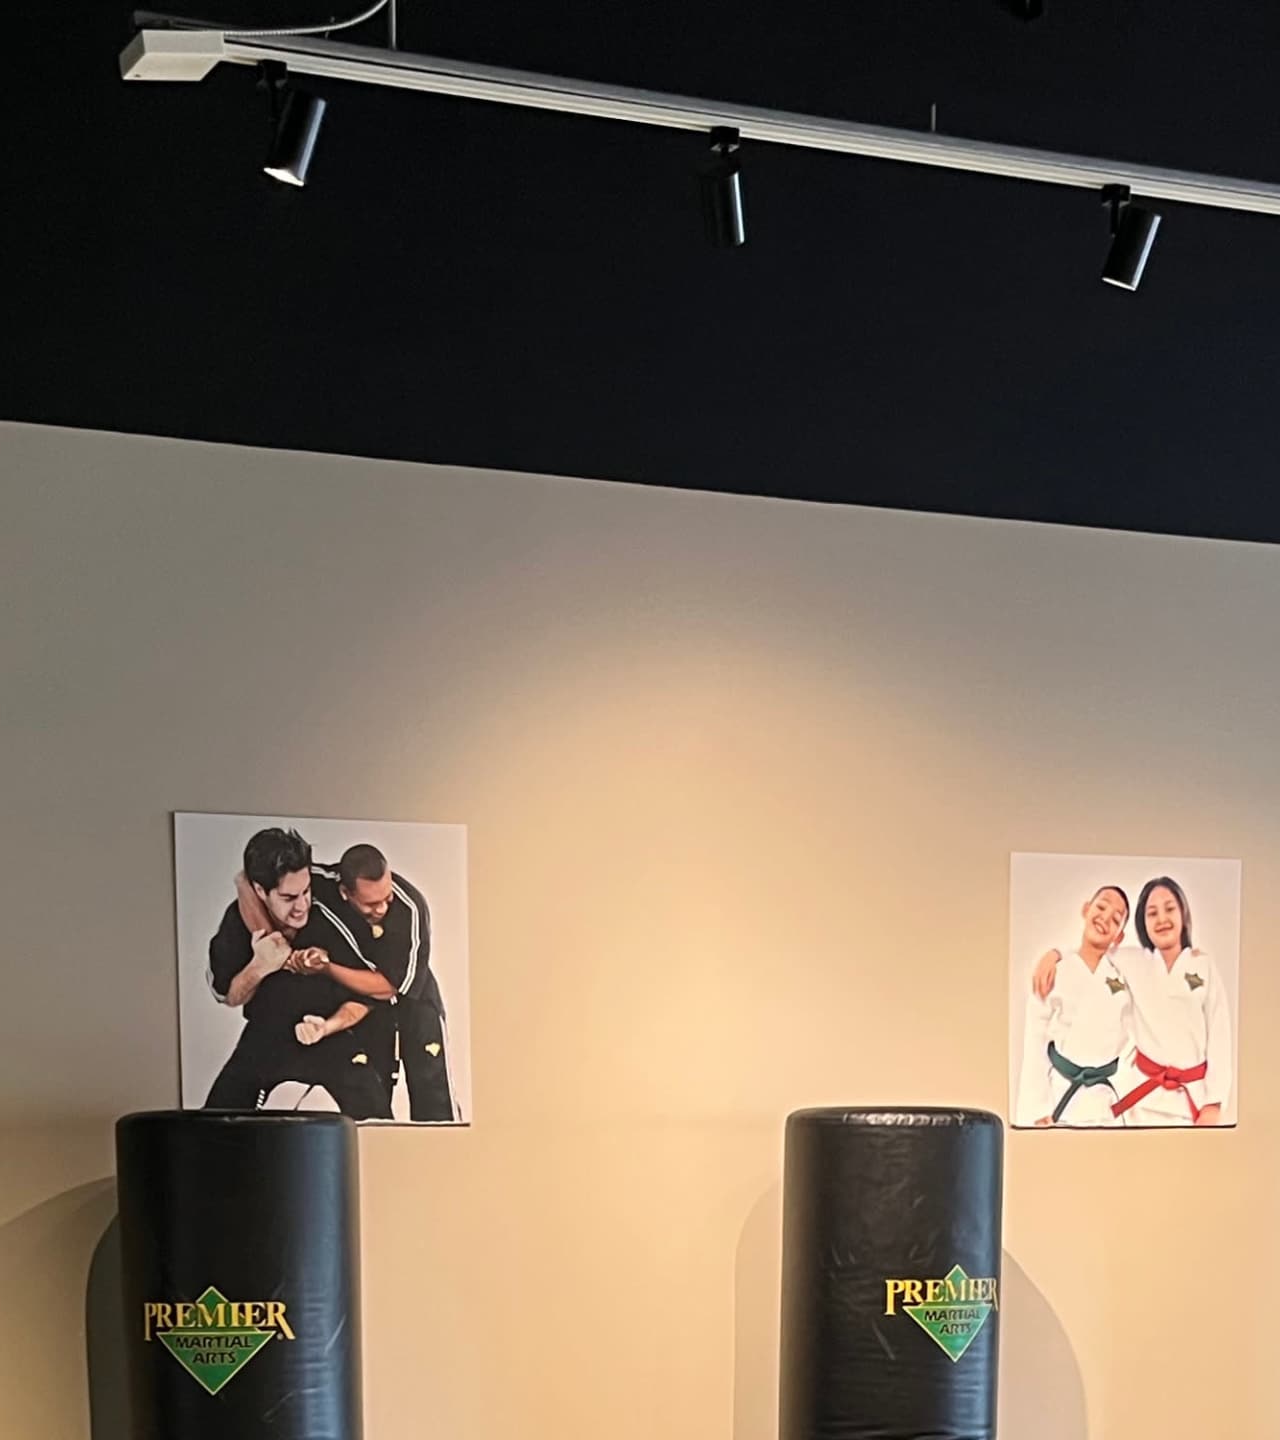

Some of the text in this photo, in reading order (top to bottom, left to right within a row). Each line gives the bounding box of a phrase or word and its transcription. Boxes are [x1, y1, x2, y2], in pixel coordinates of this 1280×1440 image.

[884, 1277, 998, 1315] PREMIER
[143, 1301, 296, 1341] PREMIER
[924, 1309, 981, 1321] MARTIAL
[939, 1323, 972, 1335] ARTS
[175, 1335, 254, 1349] MARTIAL
[192, 1352, 237, 1364] ARTS
